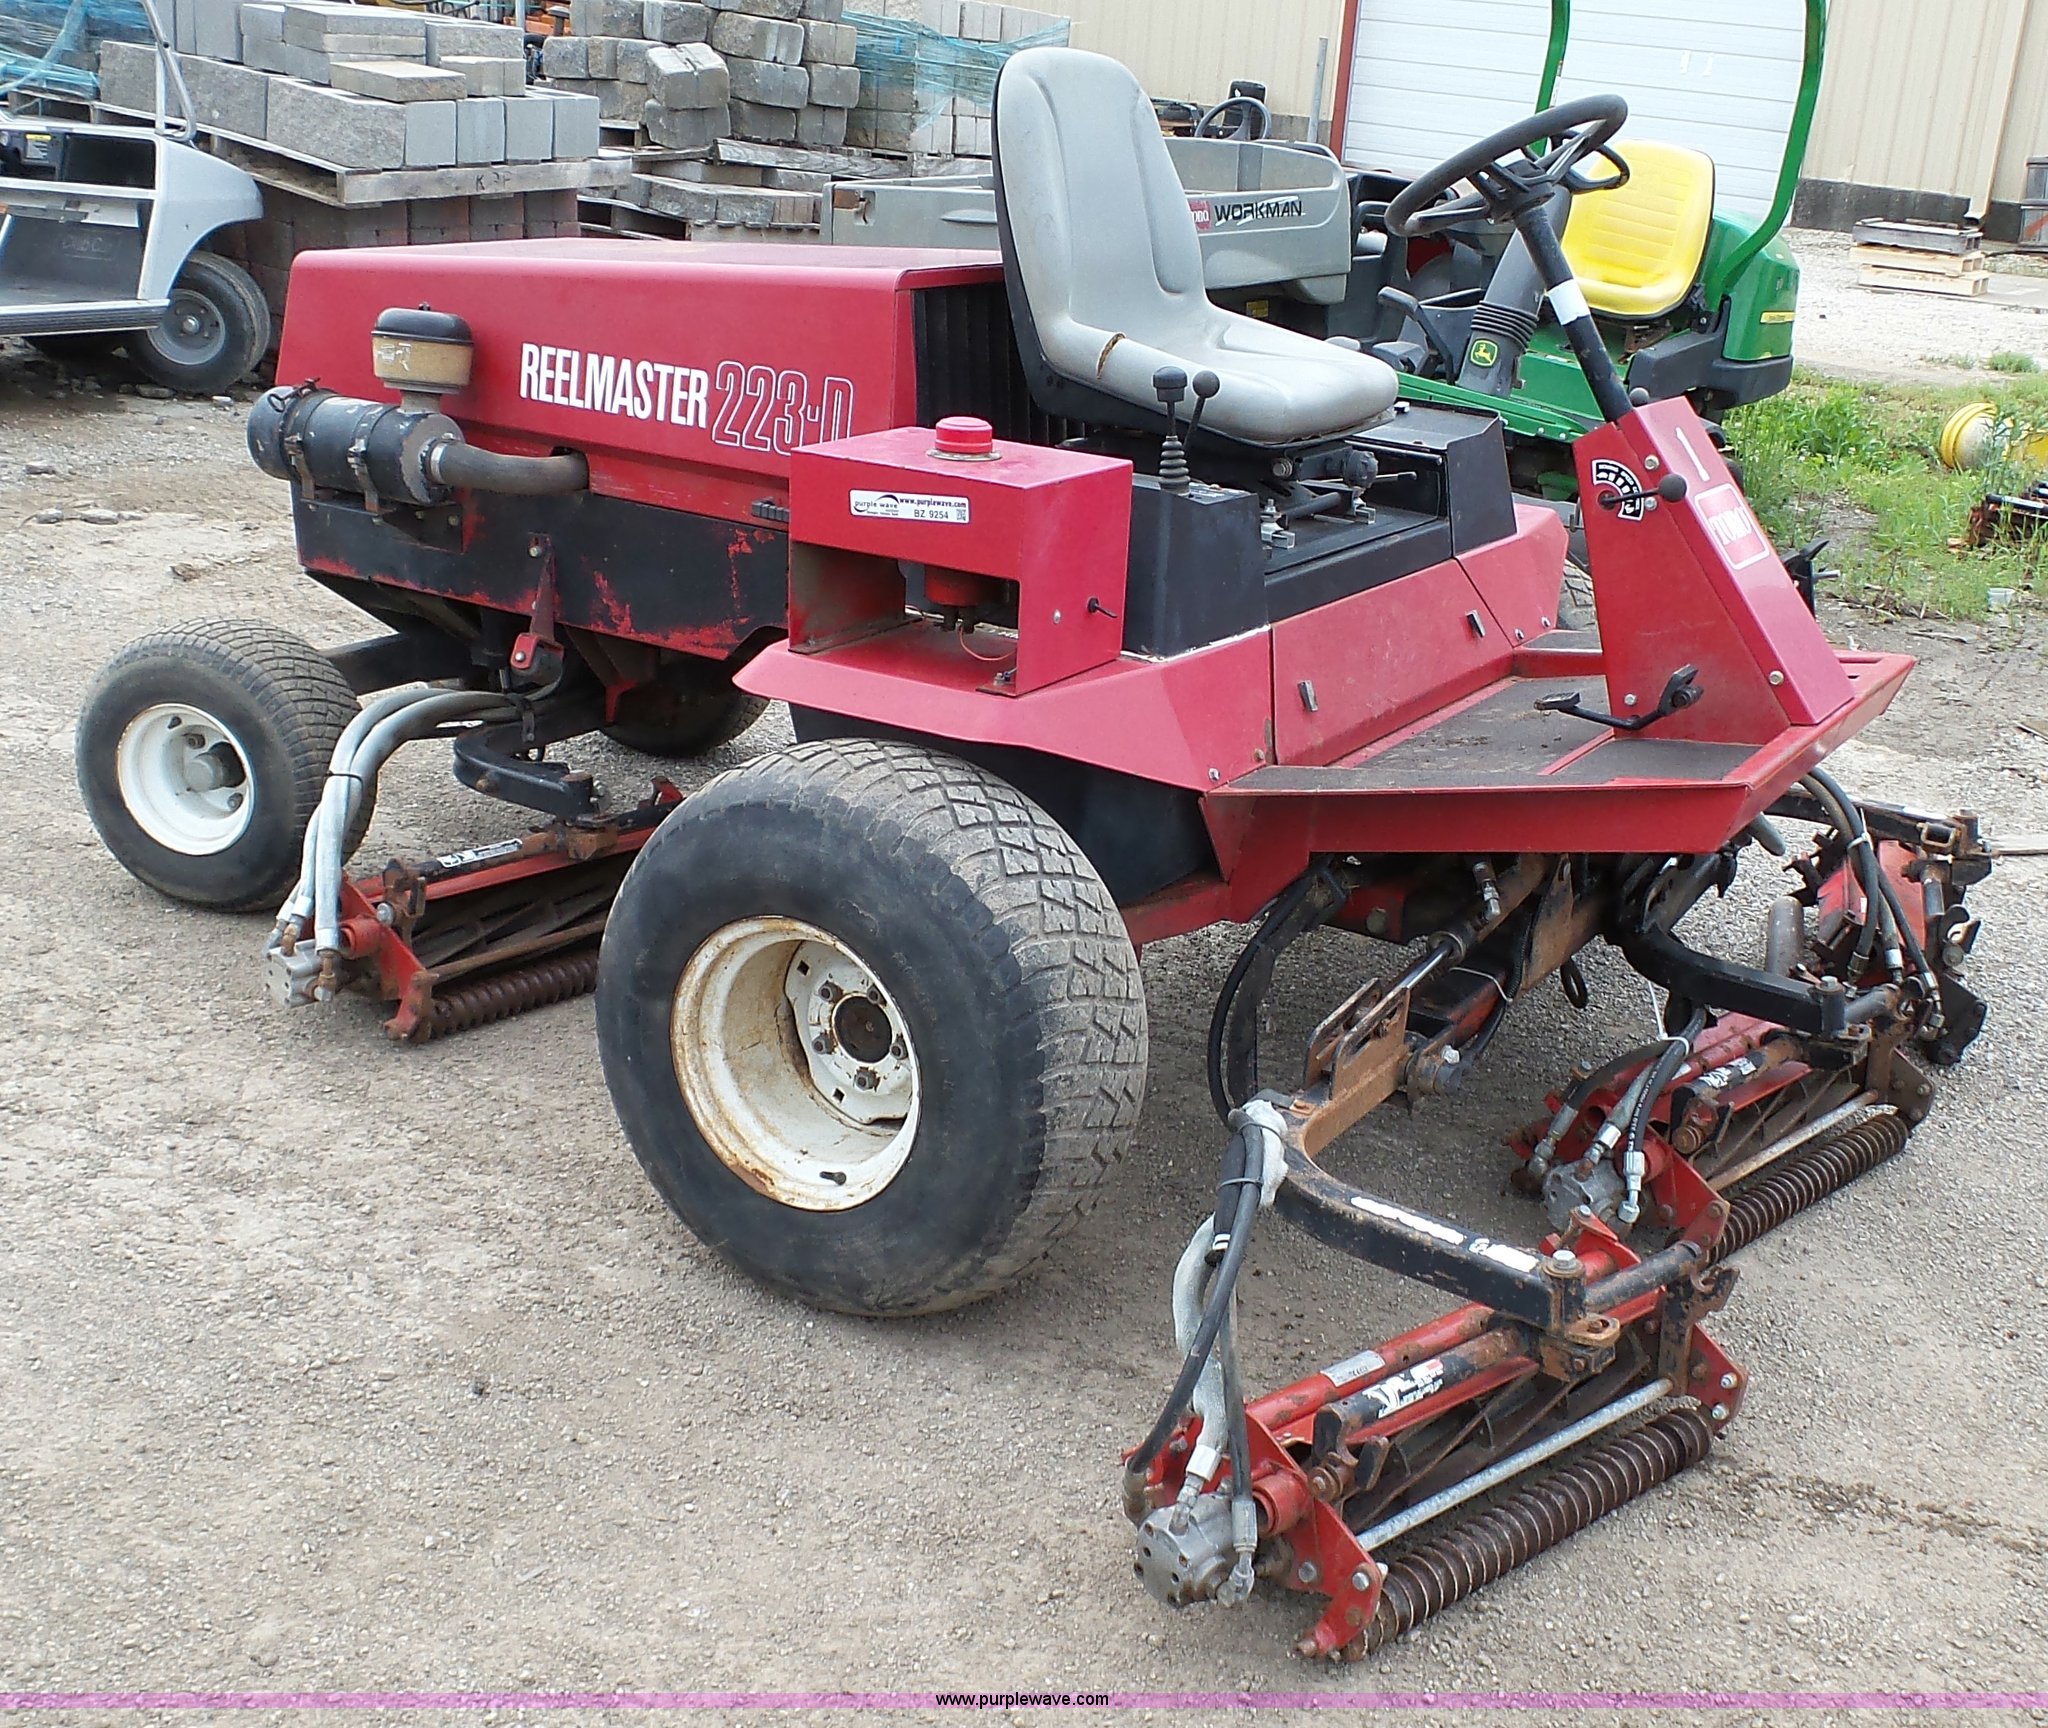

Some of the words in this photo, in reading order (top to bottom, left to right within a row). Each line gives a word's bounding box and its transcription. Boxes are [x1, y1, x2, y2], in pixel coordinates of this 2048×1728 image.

[1214, 200, 1303, 222] WORKMAN
[519, 342, 709, 429] REELMASTER
[711, 360, 854, 456] 223-D
[854, 500, 877, 509] purple
[899, 497, 966, 508] www.purplewave.com
[914, 509, 926, 518] BZ
[928, 510, 949, 519] 9254
